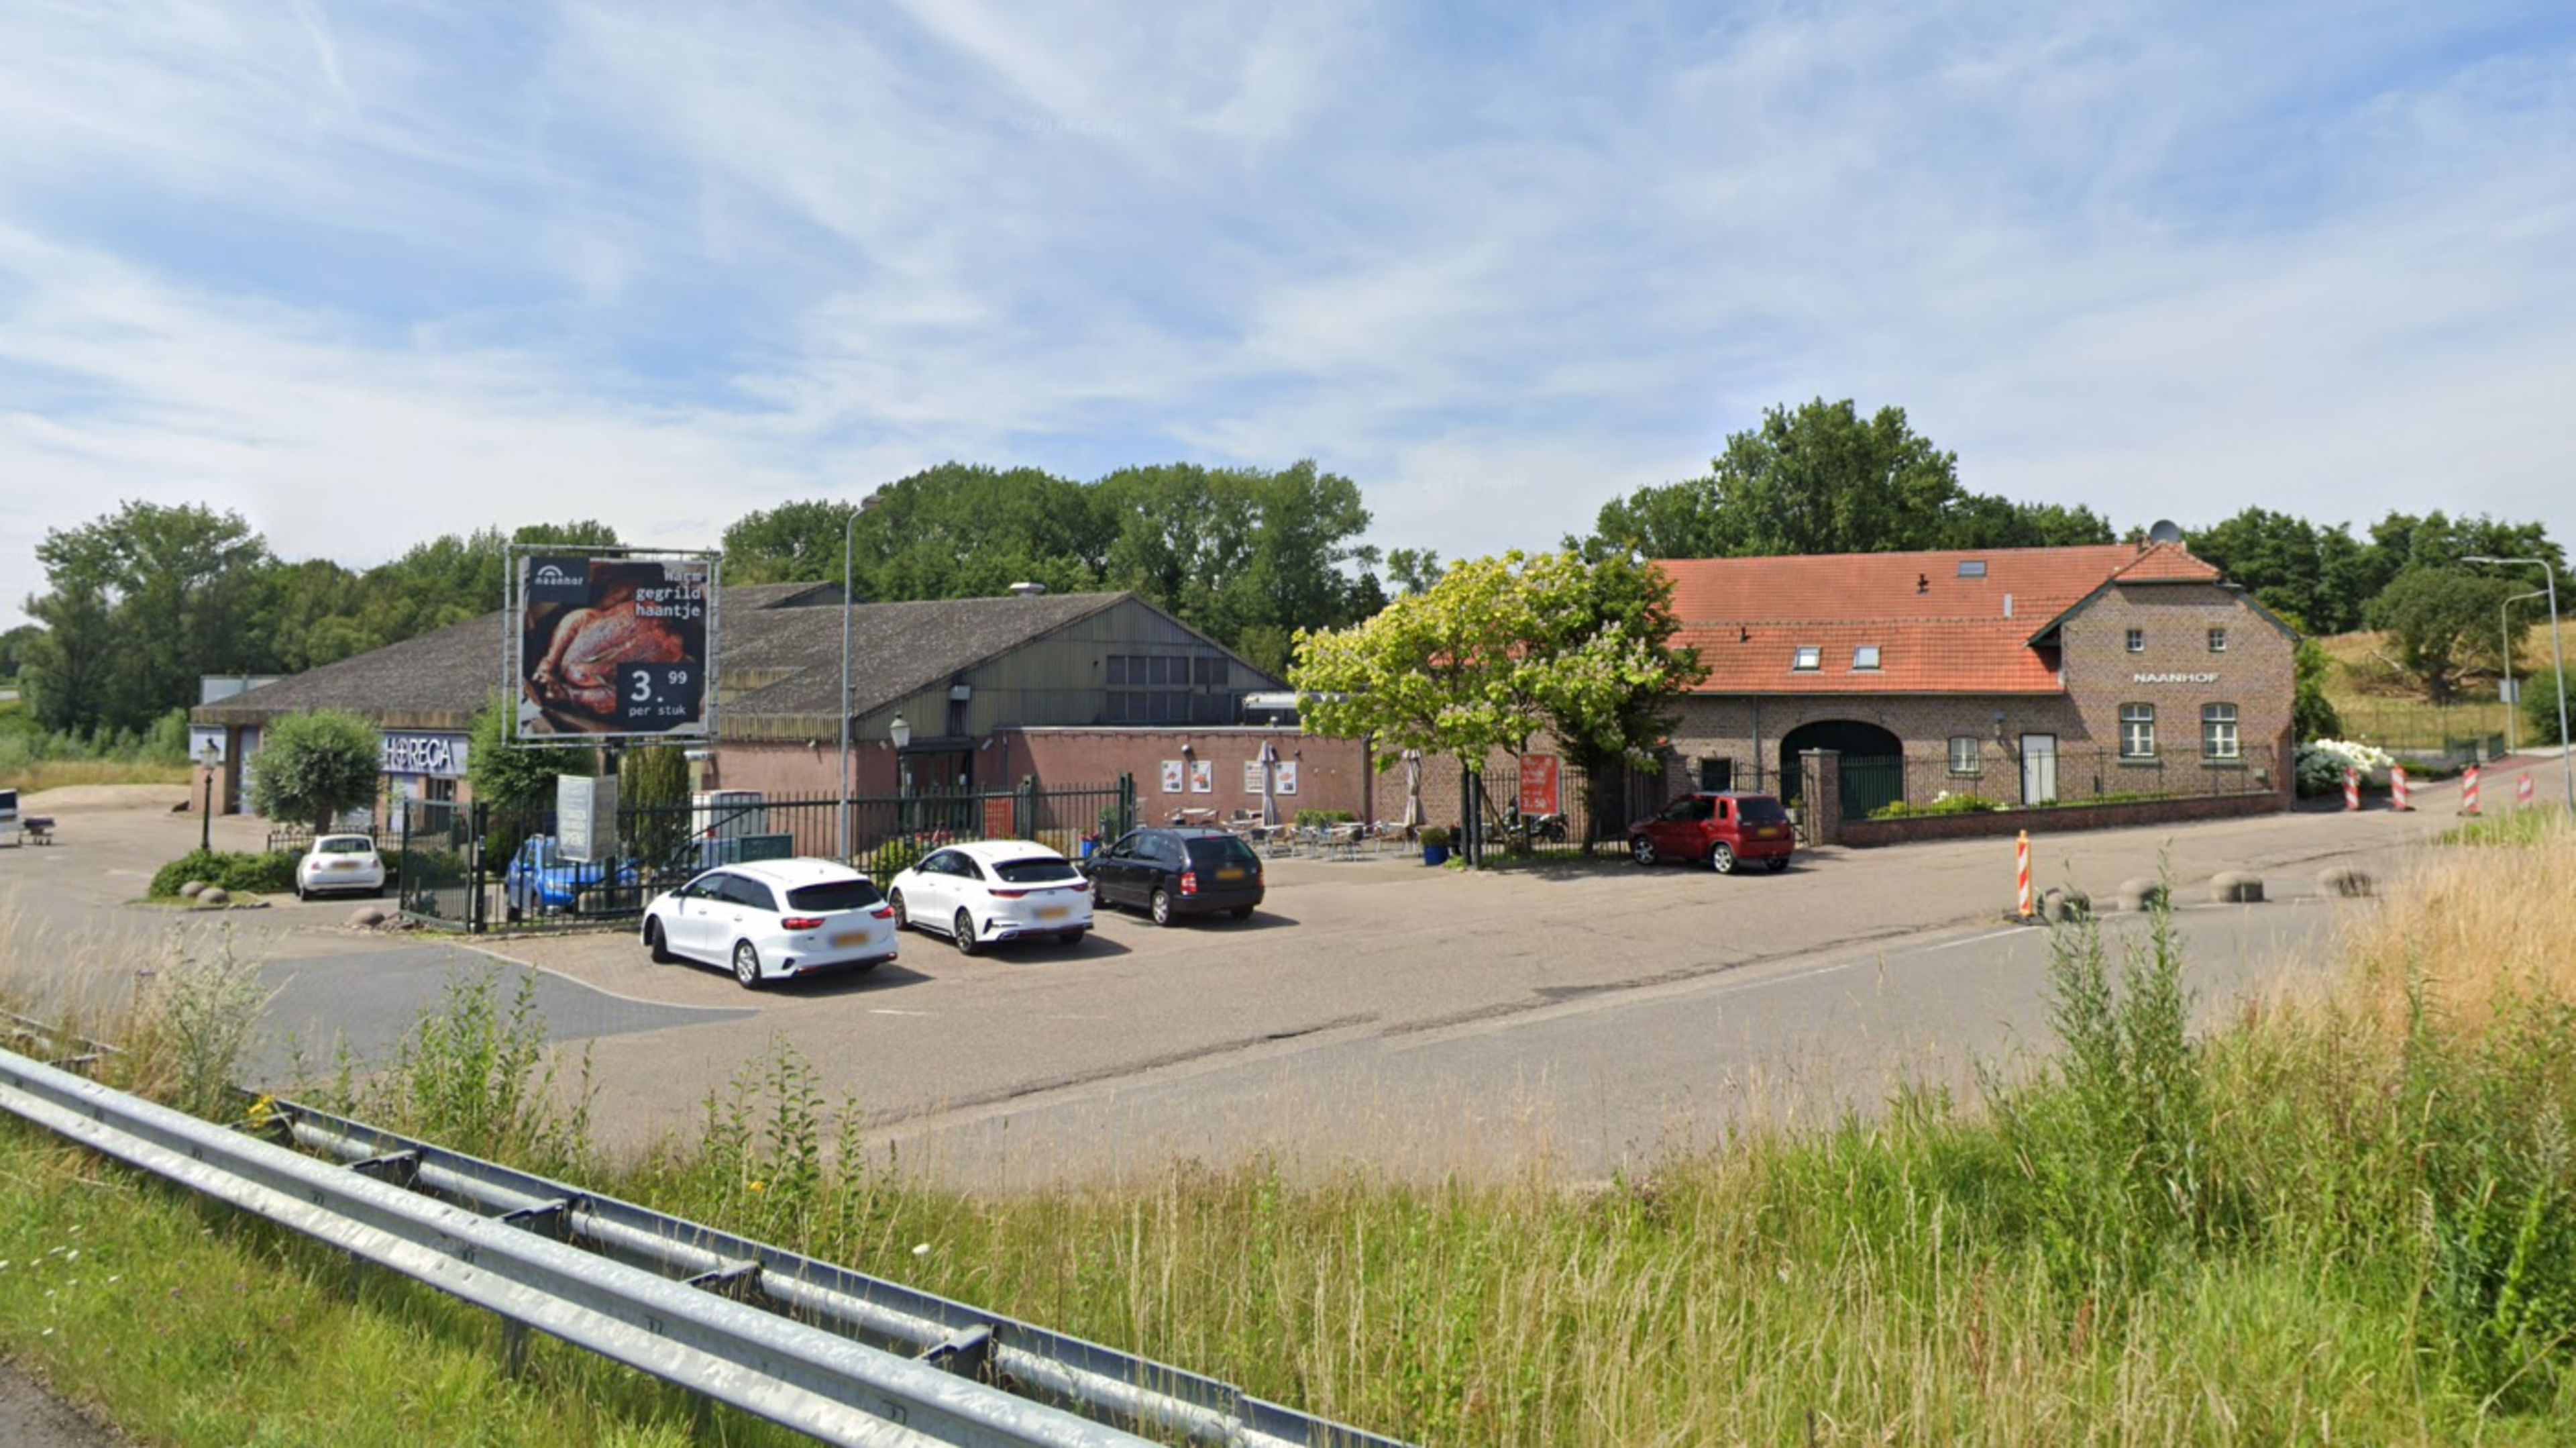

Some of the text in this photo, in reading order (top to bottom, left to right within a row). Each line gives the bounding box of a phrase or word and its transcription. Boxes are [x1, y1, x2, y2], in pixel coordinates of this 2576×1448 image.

[635, 586, 700, 602] gegrild
[635, 603, 700, 620] haantje
[2134, 673, 2220, 683] NAANHOF
[629, 705, 686, 718] per stuk
[384, 737, 455, 769] HORECA
